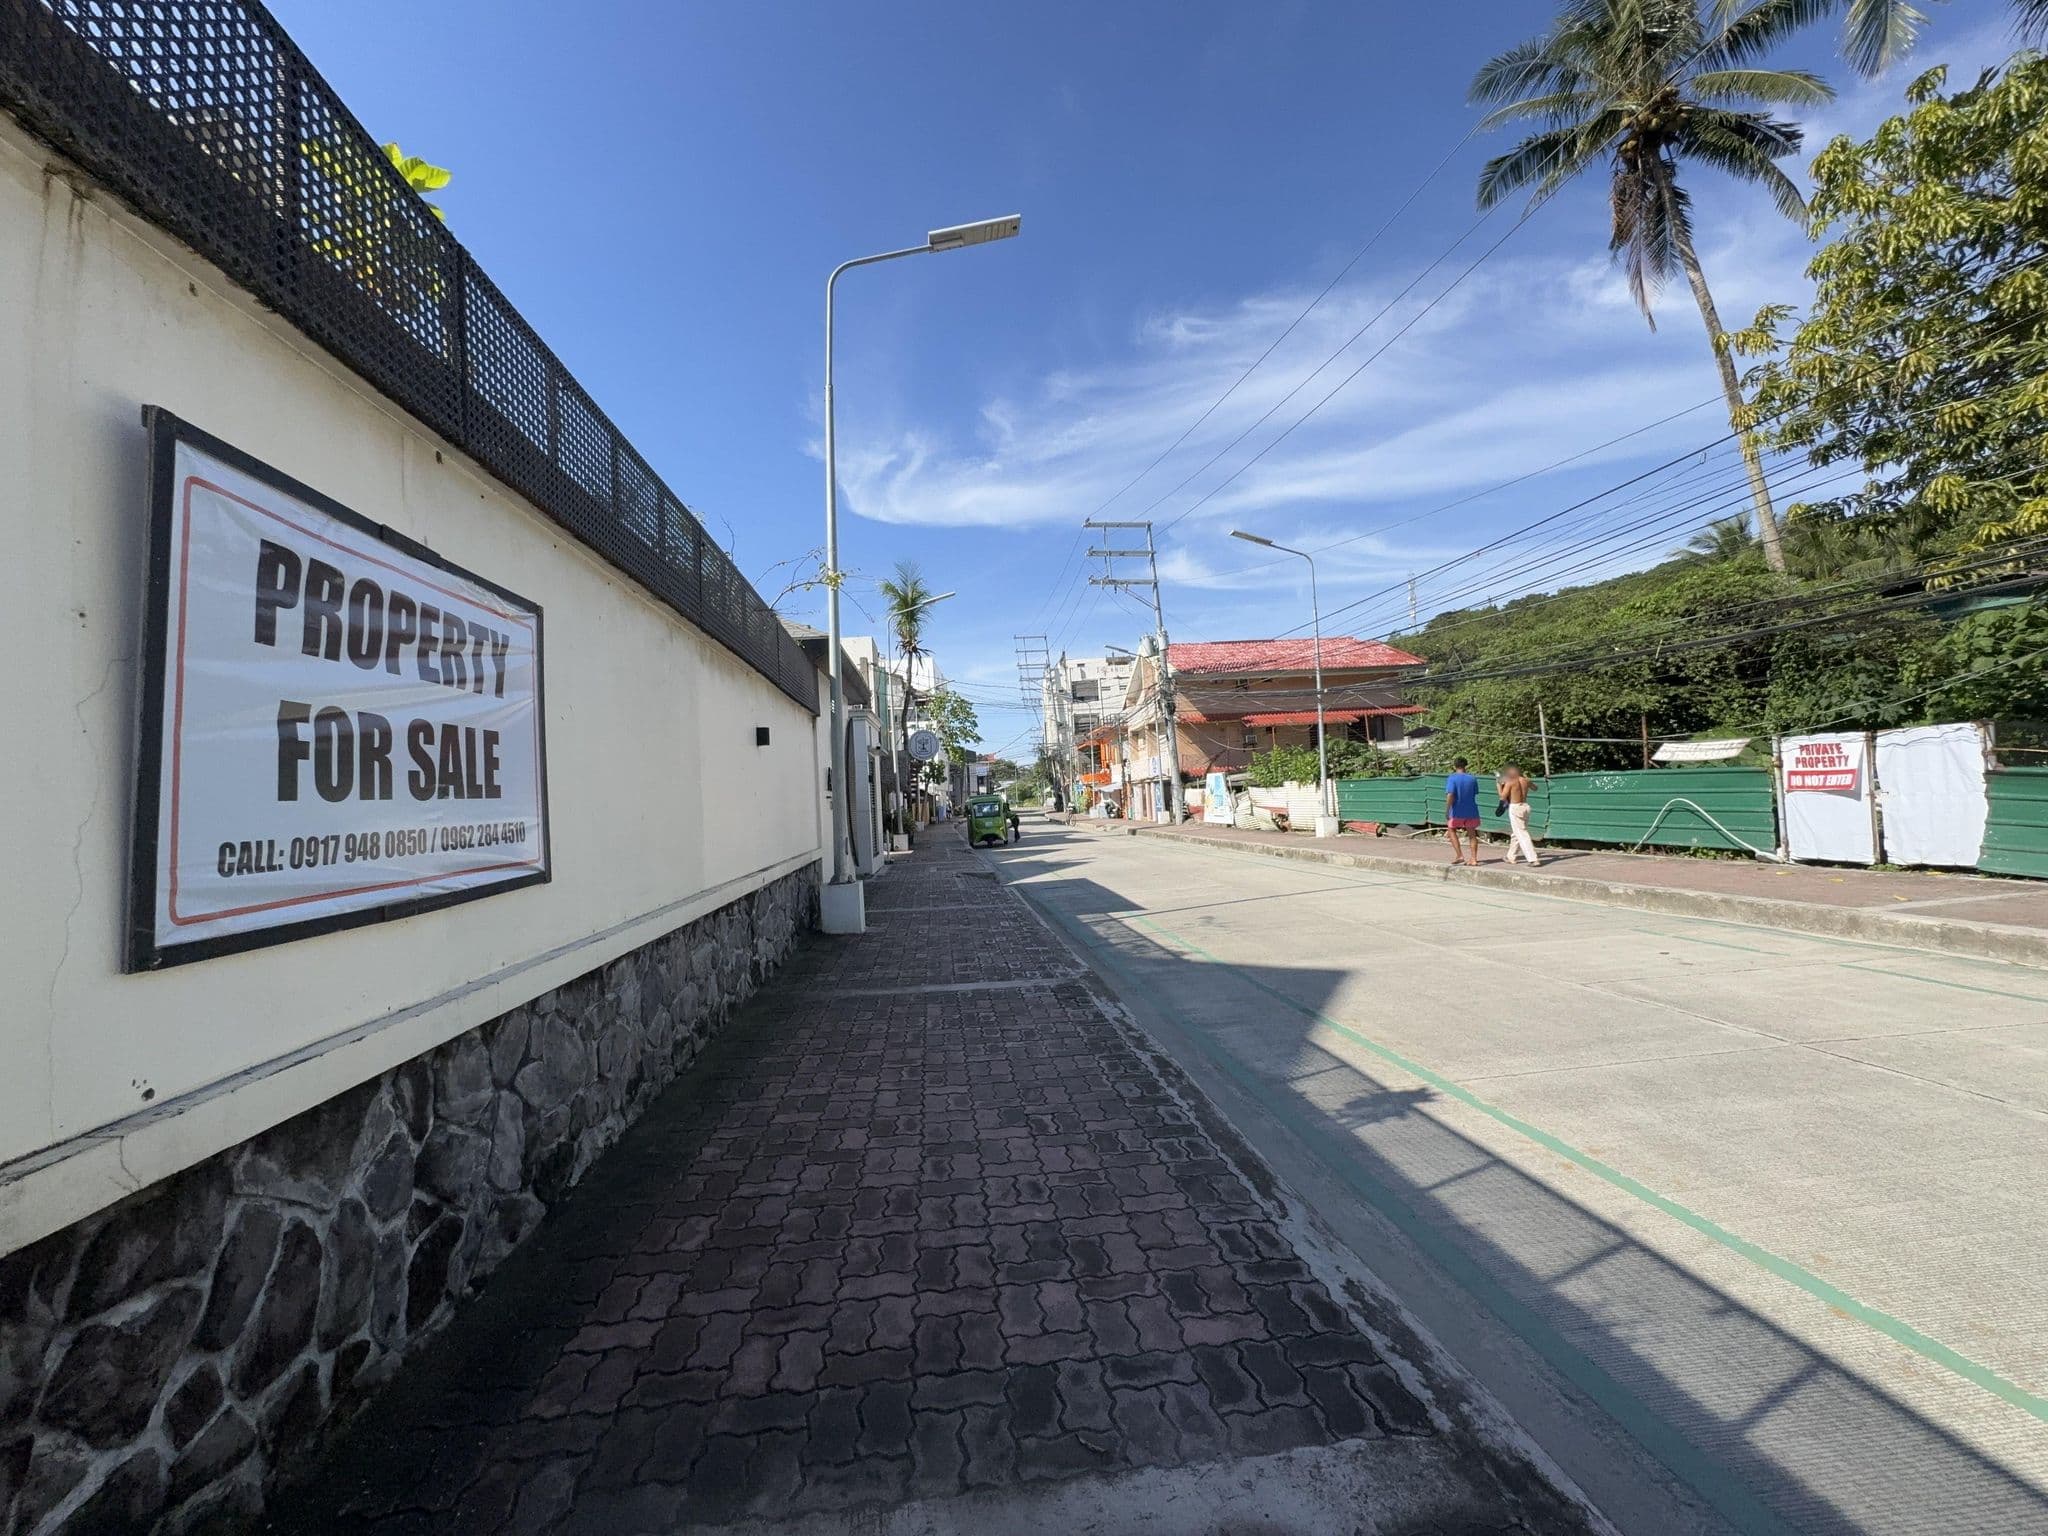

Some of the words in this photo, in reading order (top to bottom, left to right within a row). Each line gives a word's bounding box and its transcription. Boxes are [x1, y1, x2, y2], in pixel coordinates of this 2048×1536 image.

[254, 539, 510, 698] PROPERTY
[277, 700, 393, 802] FOR
[407, 718, 501, 801] SALE
[1795, 755, 1849, 768] PROPERTY
[1799, 743, 1843, 756] PRIVATE
[1790, 774, 1803, 786] DO
[1804, 774, 1825, 786] NOT
[1826, 773, 1853, 786] ENTER
[216, 839, 284, 878] CALL:
[289, 835, 340, 870] 0917
[344, 831, 381, 863] 948
[384, 828, 427, 859] 0850
[441, 825, 475, 851] 0962
[477, 823, 499, 848] 284
[501, 821, 526, 844] 4510
